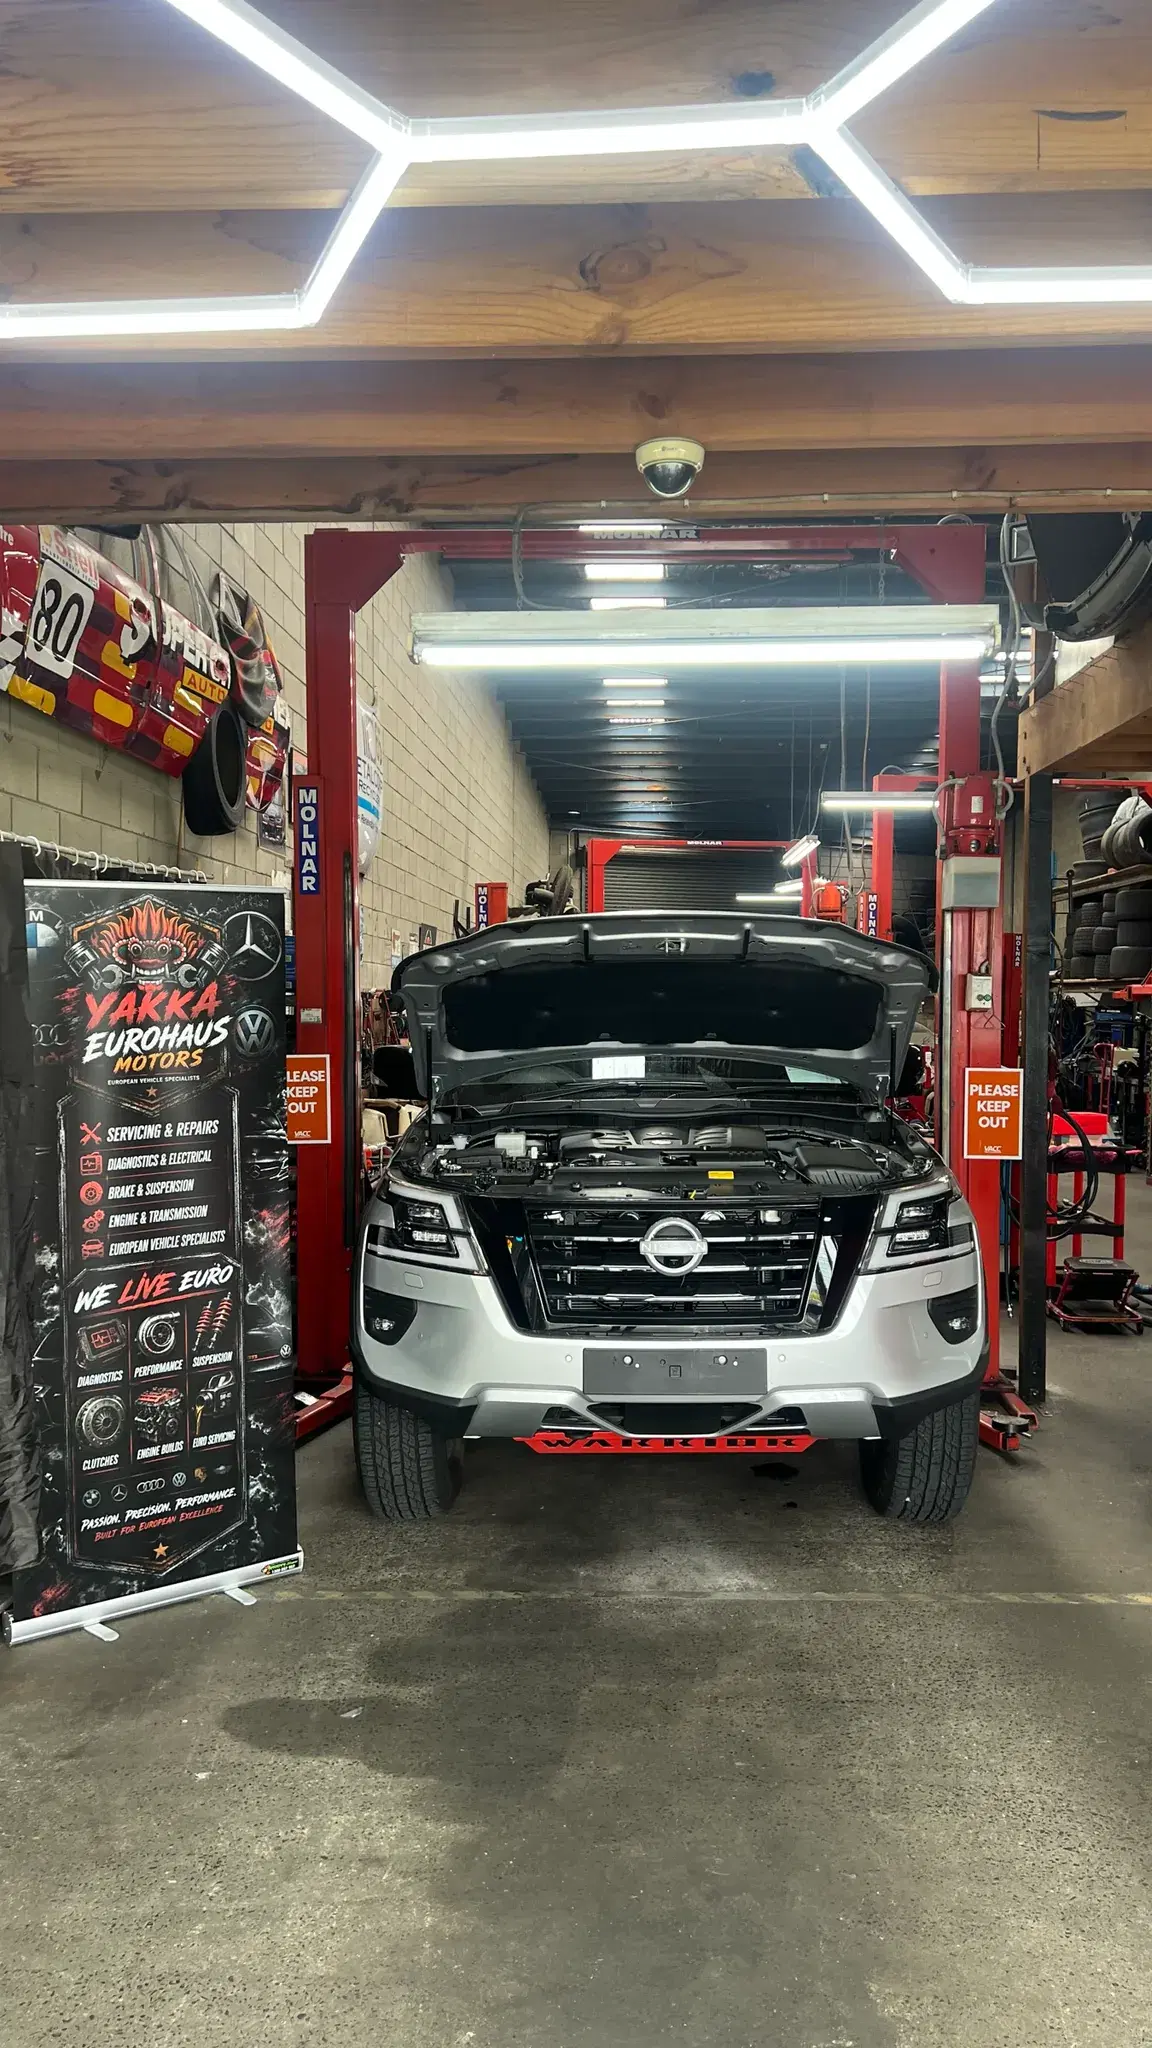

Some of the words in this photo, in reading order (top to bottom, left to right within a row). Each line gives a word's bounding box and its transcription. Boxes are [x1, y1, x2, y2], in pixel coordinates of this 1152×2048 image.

[593, 529, 698, 539] MOLNAR
[33, 578, 84, 662] 80
[187, 673, 226, 702] AUTO
[299, 788, 317, 891] MOLNAR
[478, 887, 487, 930] MOLNA
[868, 894, 877, 936] MOLNA
[1014, 935, 1022, 967] MOLNAR
[85, 981, 222, 1032] YAKKA
[82, 1015, 233, 1064] EUROHAUS
[113, 1049, 204, 1074] MOTORS
[107, 1078, 138, 1086] EUROPEAN
[164, 1075, 200, 1083] SPECIALISTS
[287, 1070, 325, 1082] LEASE
[287, 1086, 318, 1098] KEEP
[969, 1084, 1018, 1096] PLEASE
[288, 1102, 317, 1113] OUT
[977, 1100, 1011, 1112] KEEP
[107, 1123, 162, 1142] SERVICING
[164, 1123, 173, 1137] &
[176, 1120, 219, 1136] REPAIRS
[978, 1116, 1009, 1128] OUT
[107, 1154, 159, 1171] DIAGNOSTICS
[160, 1153, 167, 1166] &
[168, 1150, 212, 1165] ELECTRICAL
[108, 1184, 136, 1199] BRAKE
[137, 1184, 144, 1196] &
[145, 1179, 195, 1196] SUSPENSION
[109, 1212, 139, 1228] ENGINE
[140, 1210, 147, 1224] &
[149, 1205, 208, 1223] TRANSMISSION
[109, 1239, 149, 1256] EUROPEAN
[150, 1235, 180, 1251] VEHICLE
[181, 1230, 226, 1247] SPECIALISTS
[74, 1282, 118, 1314] WE
[117, 1269, 177, 1305] LIVE
[178, 1263, 233, 1292] EURO
[134, 1359, 184, 1378] PERFORMANCE
[192, 1351, 233, 1368] SUSPENSION
[77, 1370, 124, 1388] DIAGNOSTICS
[193, 1437, 207, 1448] EURO
[208, 1430, 236, 1445] SERVICING
[541, 1438, 796, 1448] WARRIOR
[137, 1445, 160, 1460] ENGINE
[161, 1441, 184, 1455] BUILDS
[82, 1454, 119, 1471] CLUTCHES
[94, 1528, 116, 1542] BUILT
[120, 1525, 135, 1536] FOR
